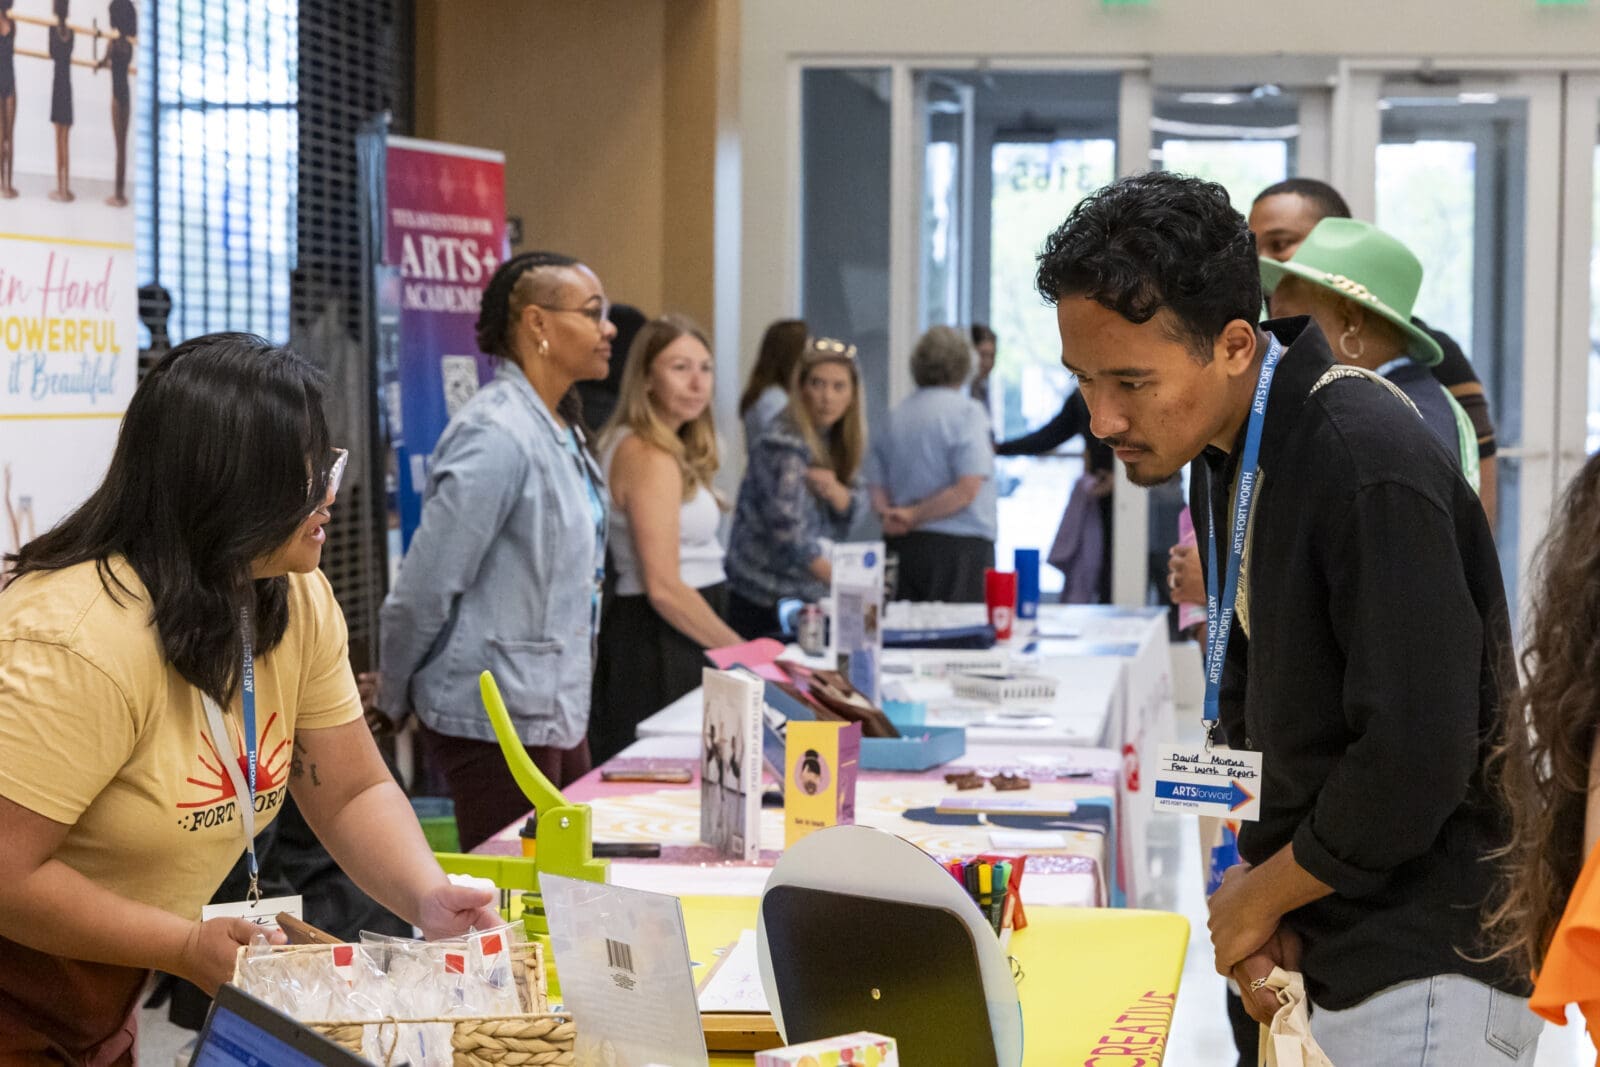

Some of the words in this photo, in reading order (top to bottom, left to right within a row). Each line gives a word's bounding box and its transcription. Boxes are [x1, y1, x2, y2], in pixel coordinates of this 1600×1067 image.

[38, 251, 114, 316] Hard
[0, 316, 121, 353] OWERFUL
[31, 352, 120, 404] Beautiful
[1258, 366, 1273, 391] FORT
[1254, 390, 1267, 415] ARTS
[1239, 472, 1253, 506] WORTH
[1236, 507, 1248, 531] FORT
[1234, 533, 1245, 554] ARTS
[1209, 595, 1217, 619] ARTS
[1218, 608, 1232, 638] WORTH
[1213, 640, 1225, 661] FORT
[1210, 662, 1221, 684] ARTS
[1173, 753, 1199, 763] David
[1172, 763, 1188, 771] Fort
[1227, 768, 1258, 779] Report
[189, 801, 236, 832] FORT
